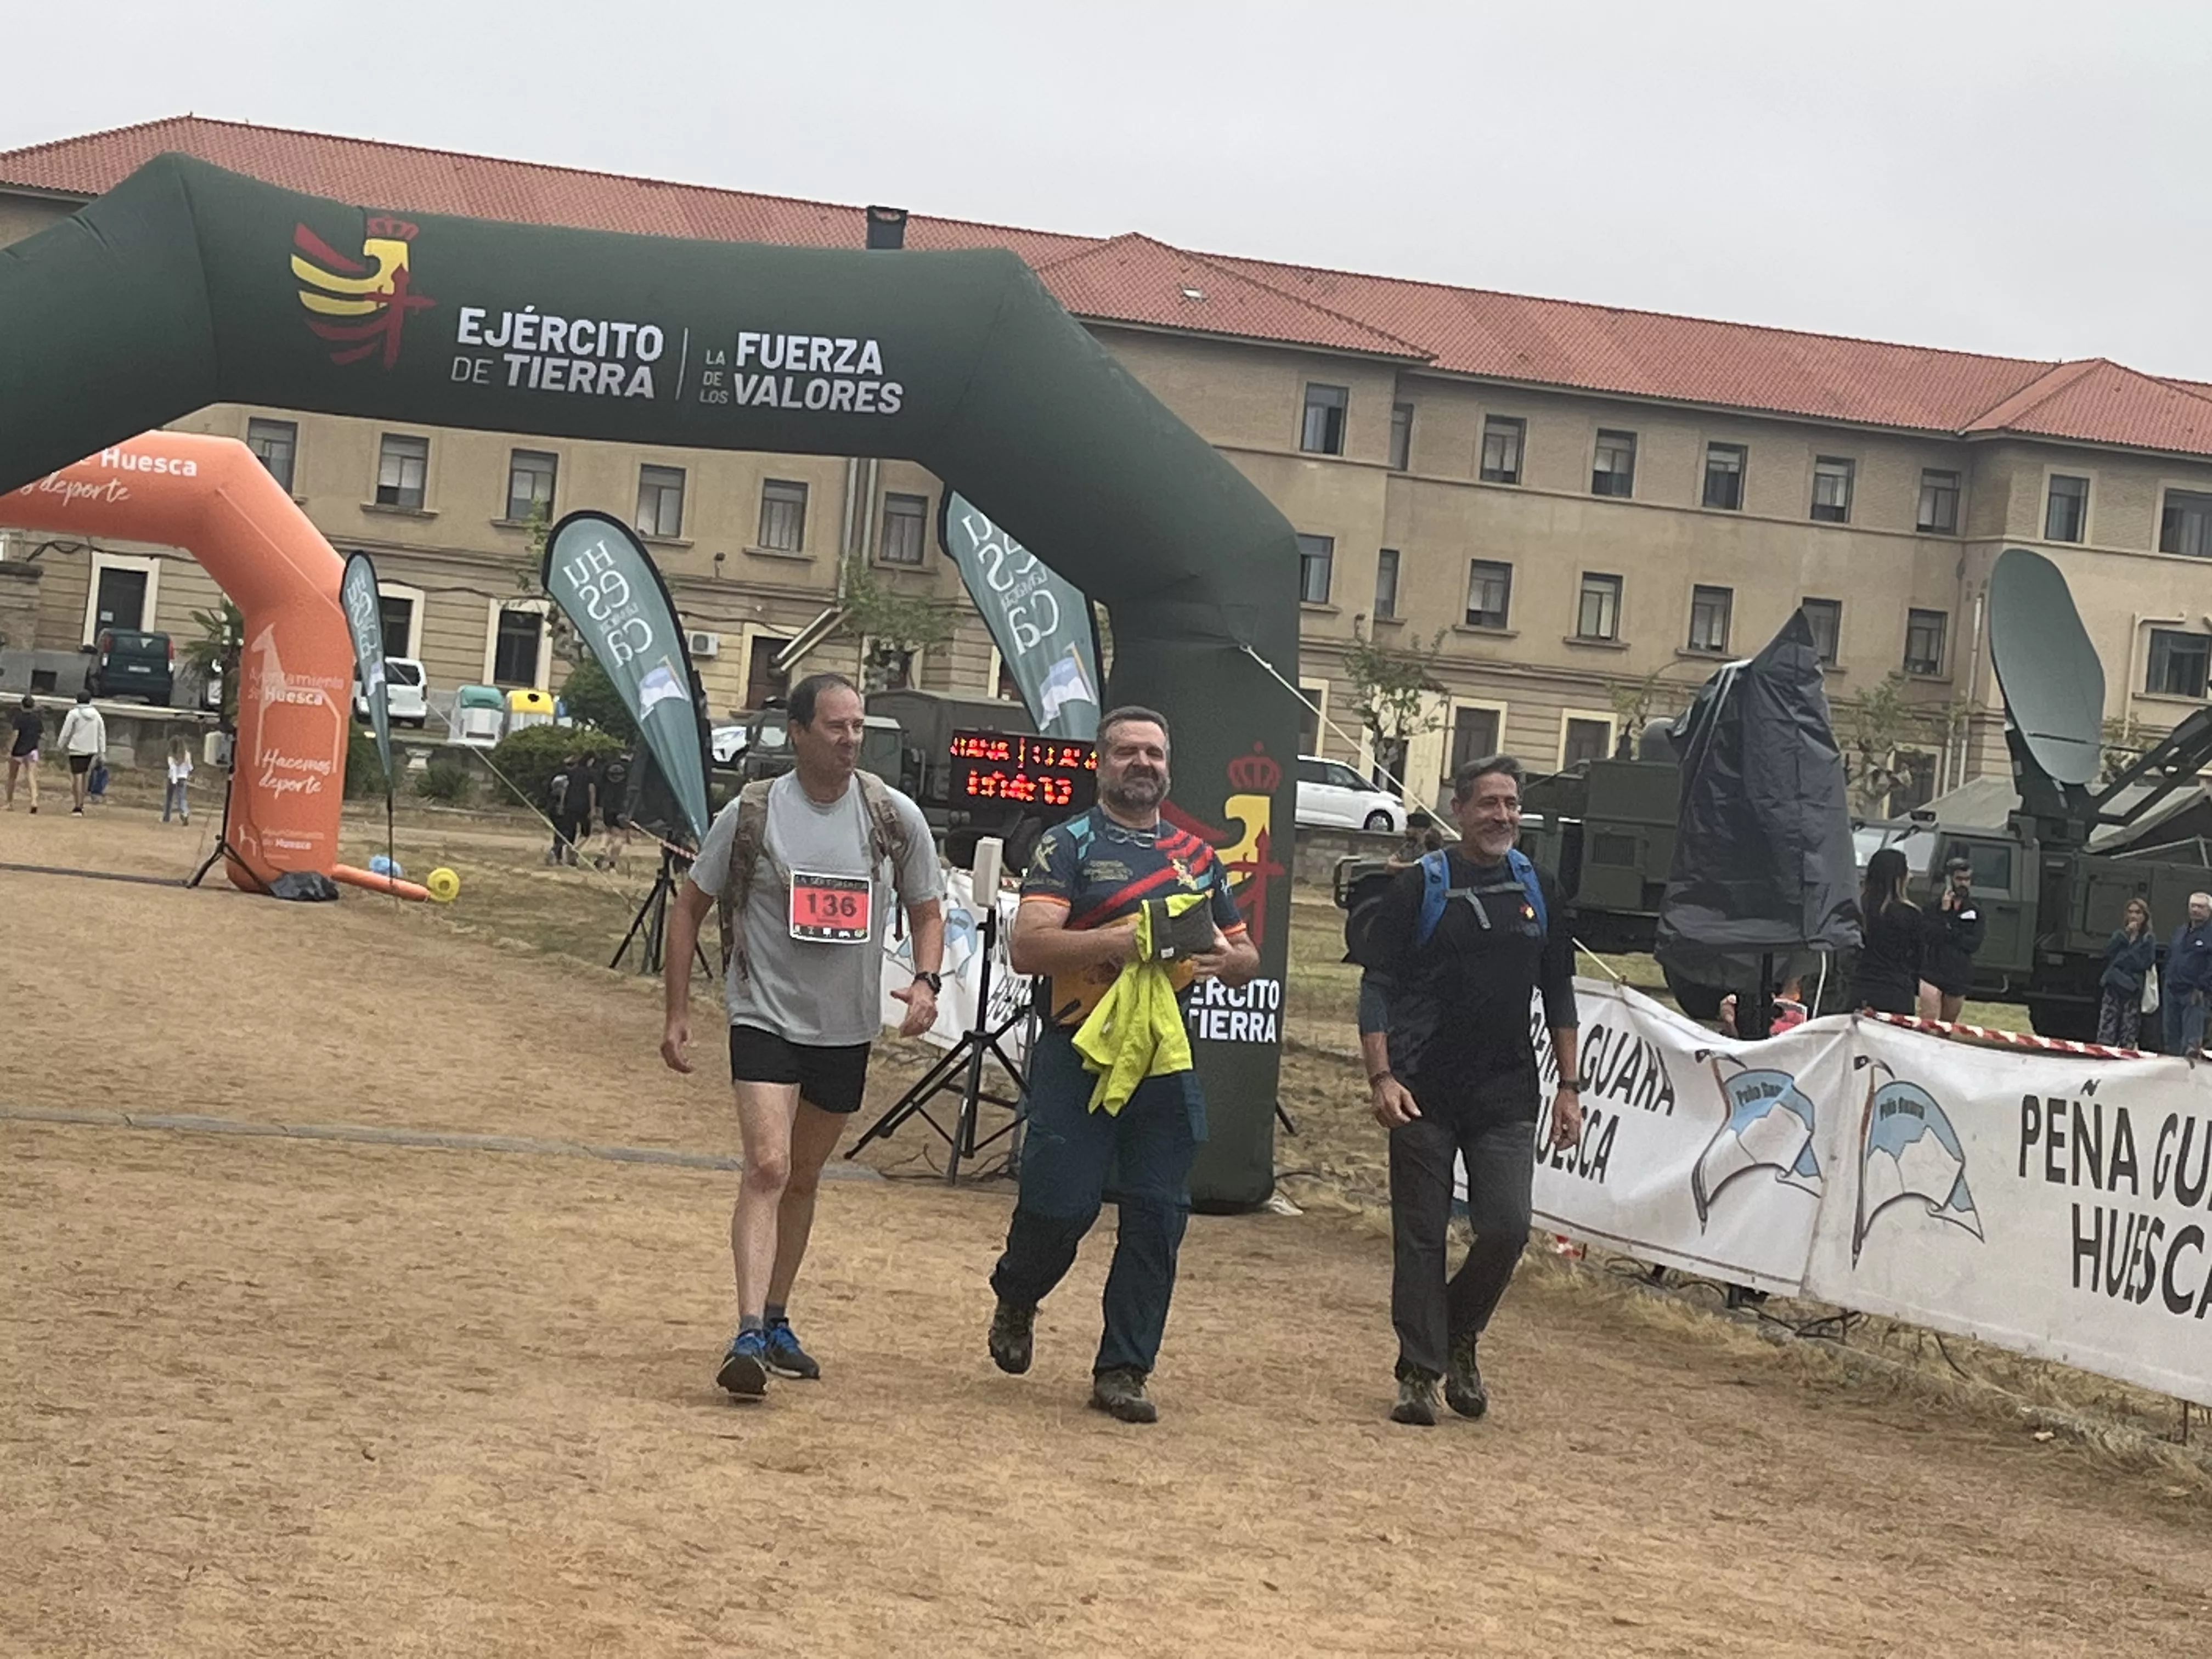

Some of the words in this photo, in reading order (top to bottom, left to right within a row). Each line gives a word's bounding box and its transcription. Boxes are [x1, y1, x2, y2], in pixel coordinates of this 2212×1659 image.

[457, 305, 664, 362] EJÉRCITO
[705, 349, 726, 366] LA
[736, 331, 884, 376] FUERZA
[450, 356, 494, 385] DE
[503, 353, 655, 399] TIERRA
[698, 388, 730, 405] LOS
[733, 373, 904, 415] VALORES
[702, 371, 724, 387] DE
[100, 447, 198, 477] Huesca
[265, 686, 323, 706] Huesca
[261, 748, 332, 776] Hacemos
[807, 893, 857, 917] 136
[2018, 1079, 2138, 1195] PEÑA
[2153, 1112, 2212, 1210] GU
